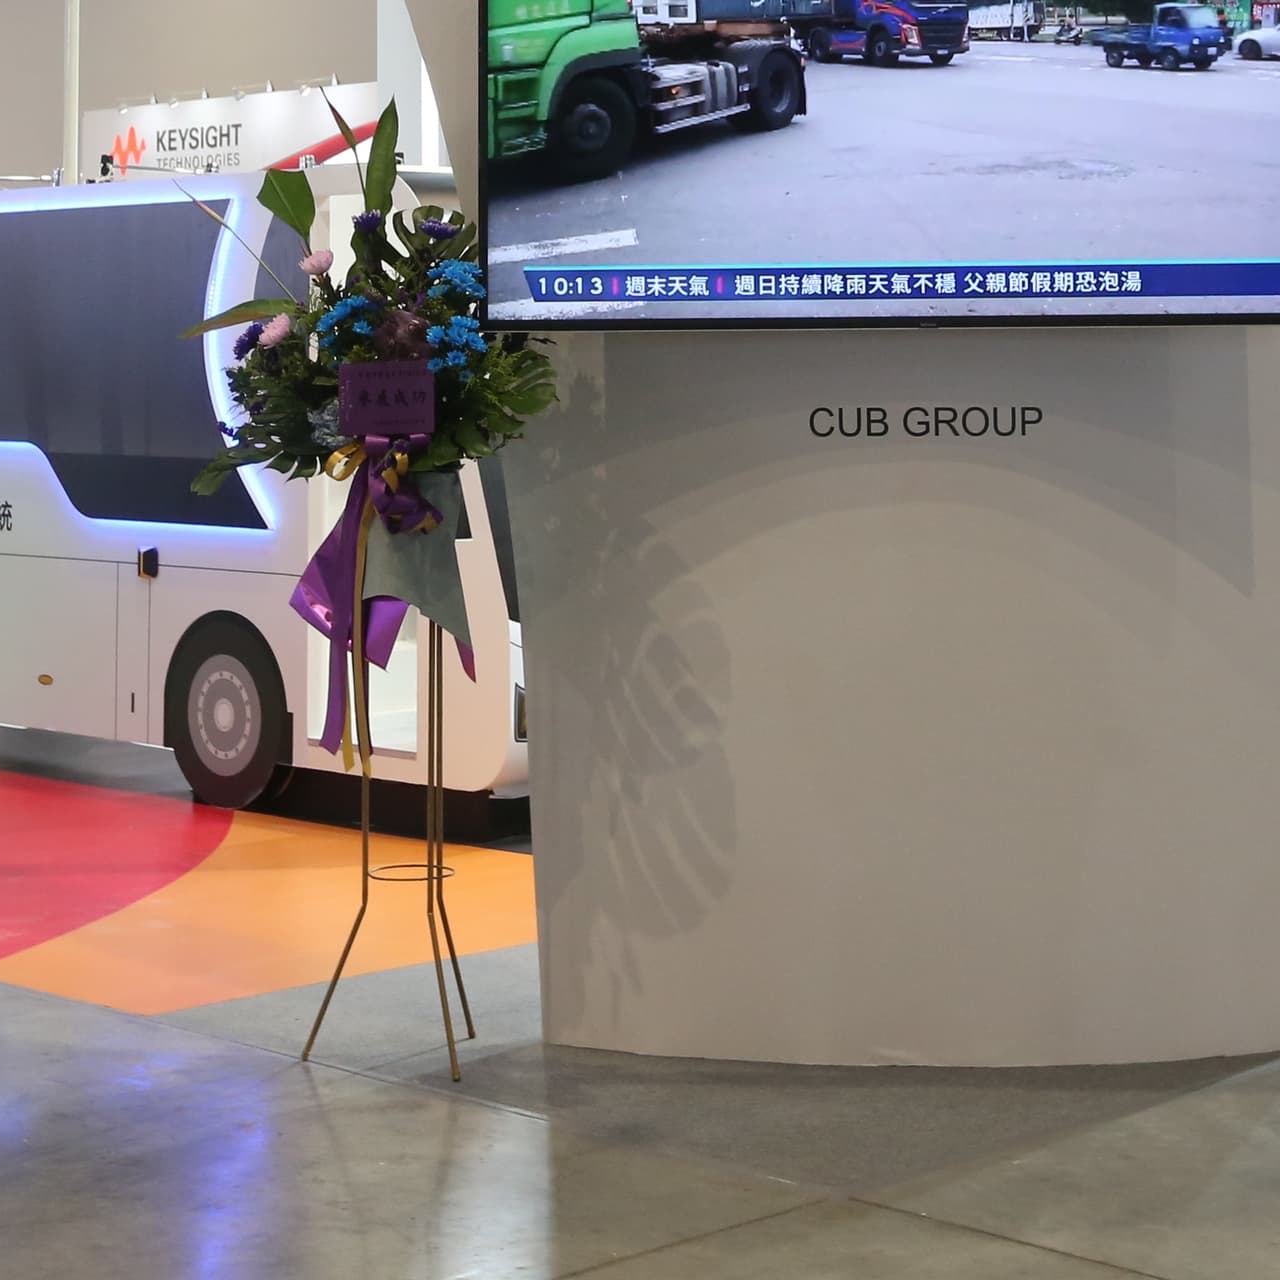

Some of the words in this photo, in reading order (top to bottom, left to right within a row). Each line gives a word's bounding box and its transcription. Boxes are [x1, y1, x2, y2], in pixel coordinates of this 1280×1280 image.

[156, 124, 242, 152] KEYSIGHT
[538, 276, 604, 295] 10:13
[624, 275, 710, 297] 週末天氣
[734, 272, 956, 296] 週日持續降雨天氣不穩
[963, 271, 1142, 294] 父親節假期恐泡湯
[809, 407, 889, 437] CUB
[902, 406, 1043, 437] GROUP
